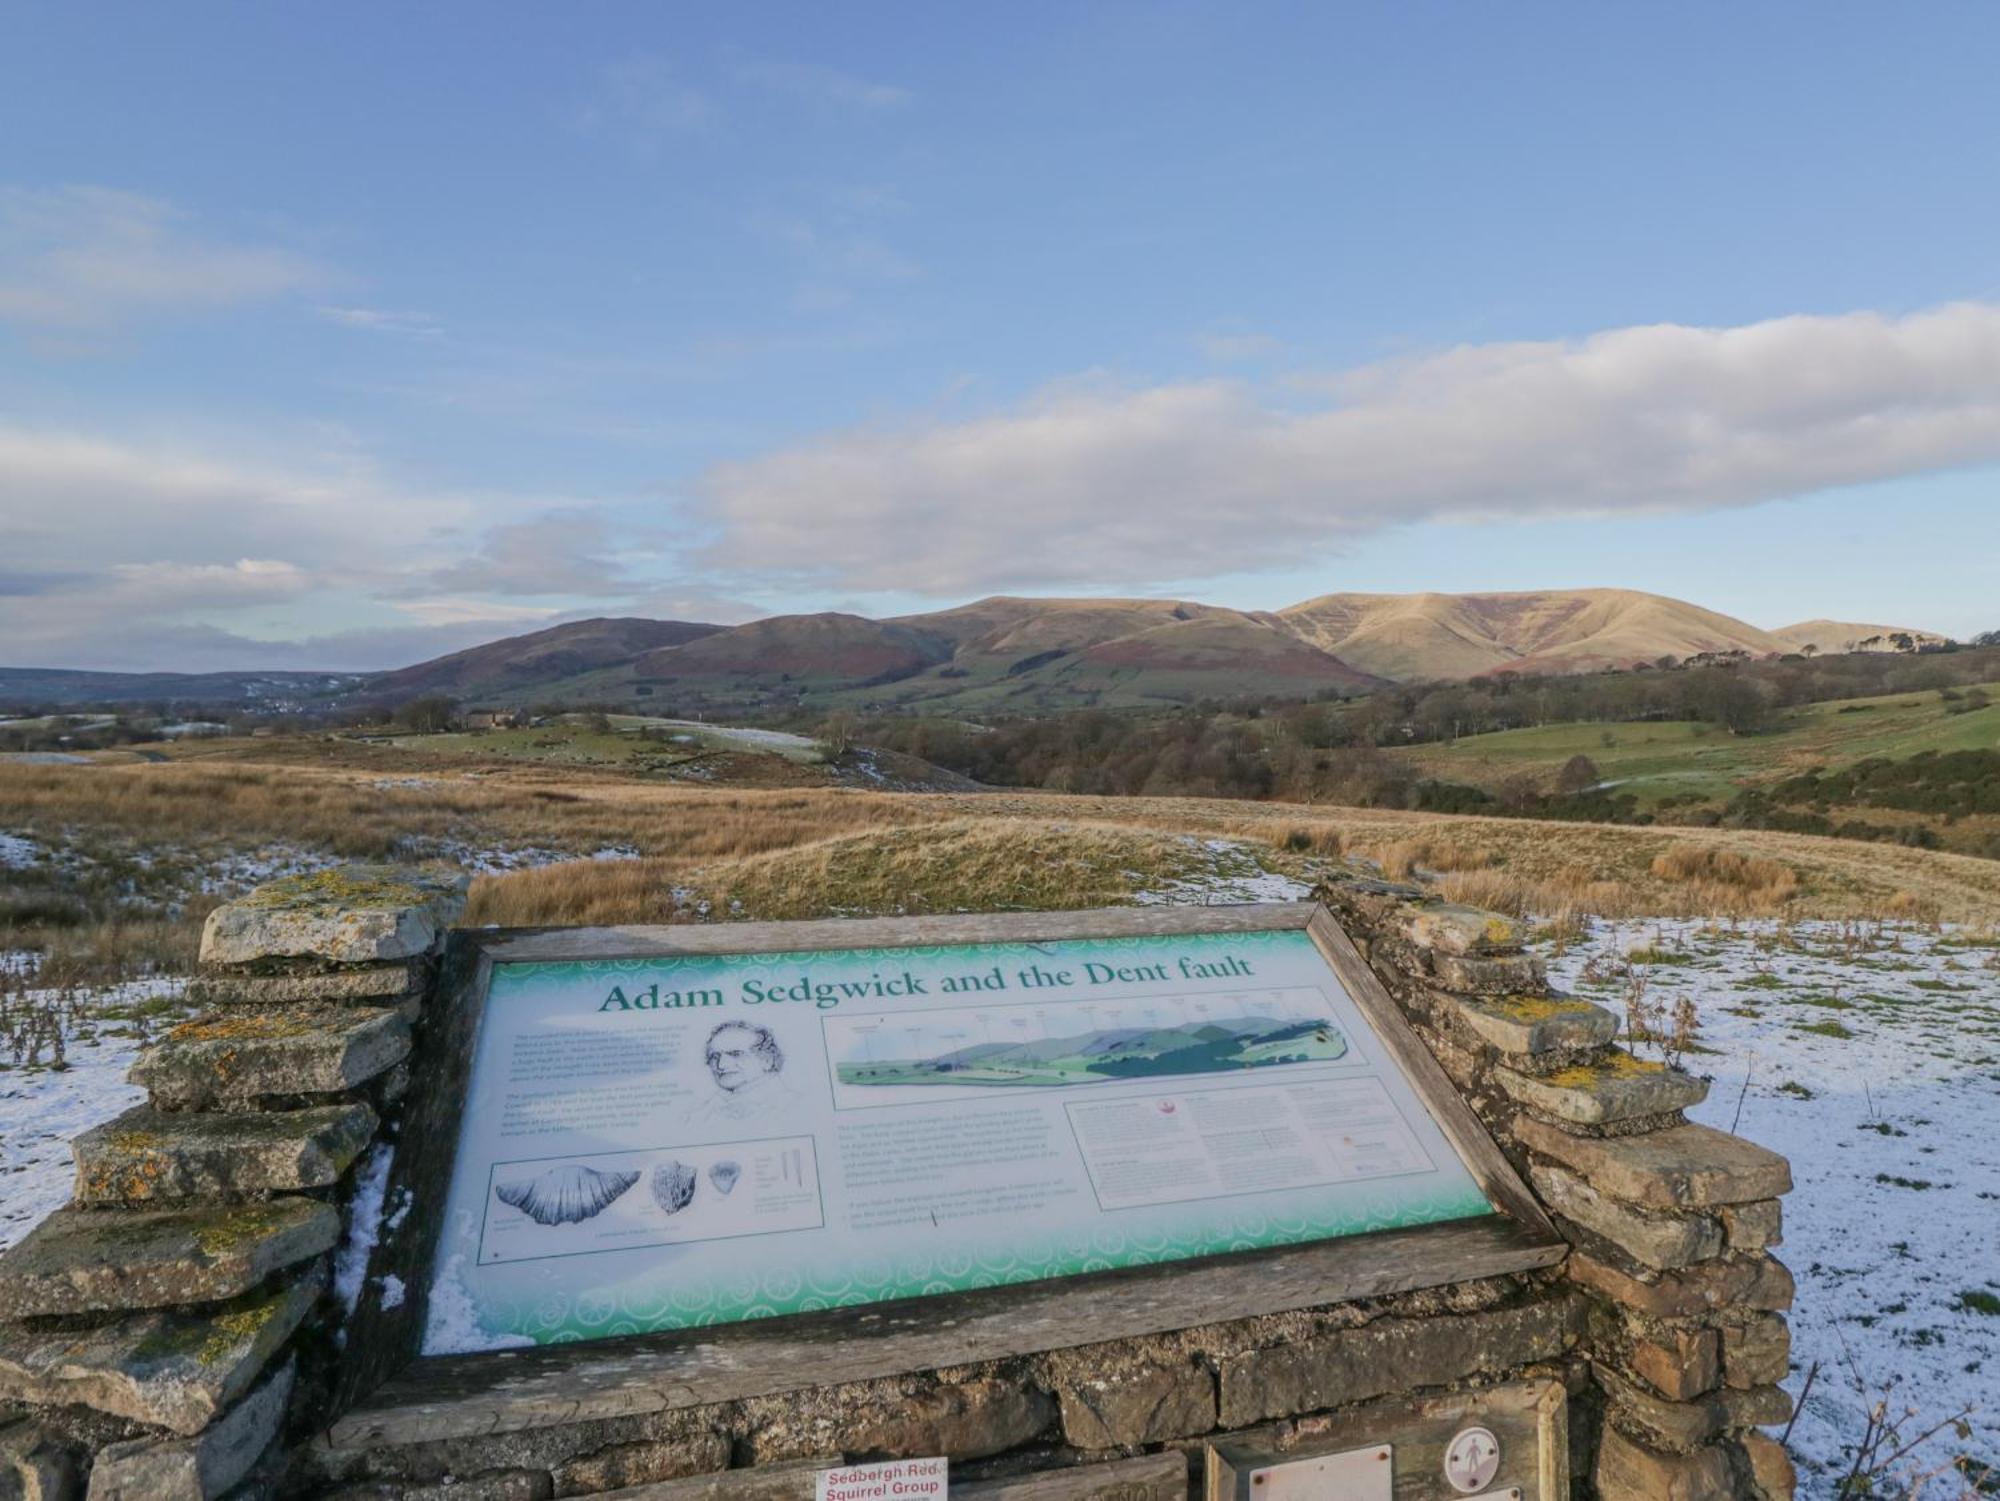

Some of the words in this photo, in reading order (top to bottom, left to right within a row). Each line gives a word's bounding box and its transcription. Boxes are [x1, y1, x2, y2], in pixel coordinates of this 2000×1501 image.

[598, 984, 725, 1013] Adam
[742, 972, 929, 1008] Sedgwick
[941, 967, 1008, 993] and
[1018, 966, 1074, 988] the
[1083, 961, 1171, 985] Dent
[1178, 956, 1256, 979] fault
[829, 1466, 902, 1485] Sedbergh
[908, 1463, 937, 1477] Red
[827, 1483, 886, 1501] Squirrel
[892, 1481, 939, 1495] Group
